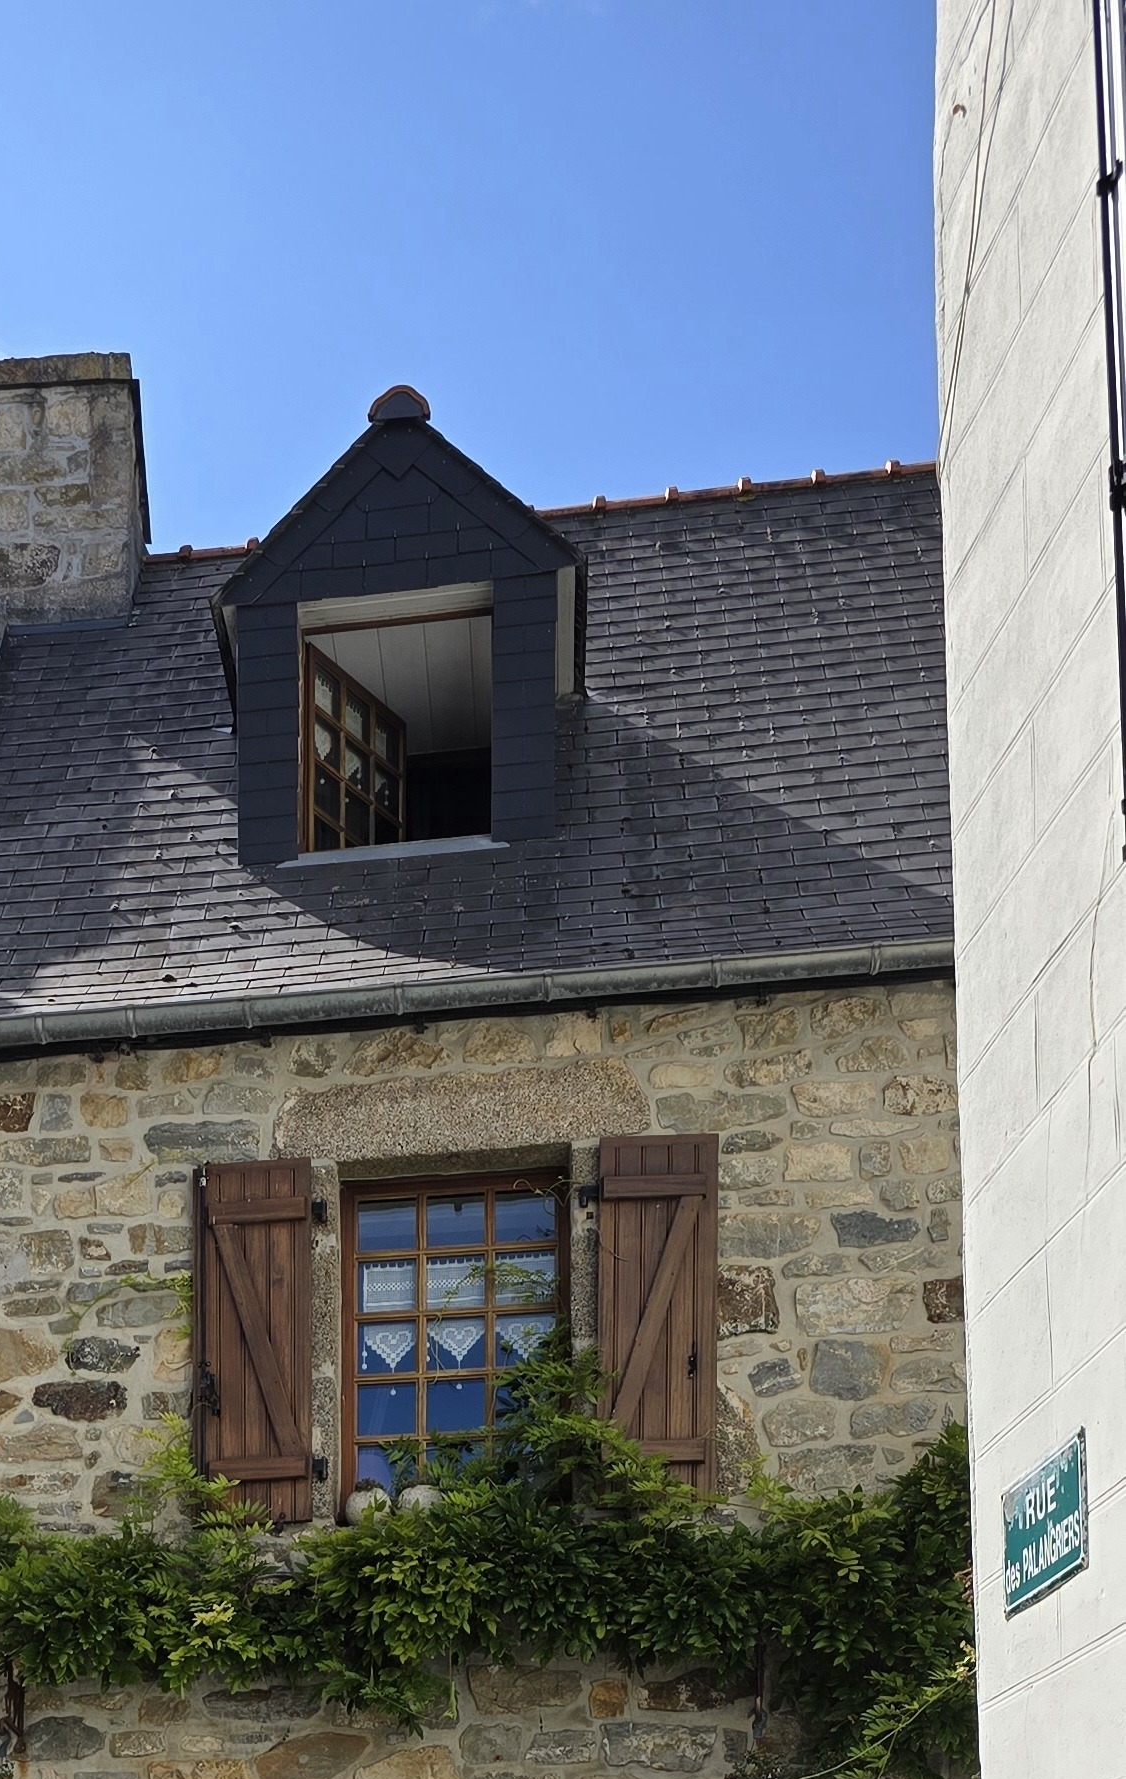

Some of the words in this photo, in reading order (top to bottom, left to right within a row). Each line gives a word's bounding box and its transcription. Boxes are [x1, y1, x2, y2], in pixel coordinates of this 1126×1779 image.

[1025, 1474, 1058, 1530] RUE
[1005, 1558, 1021, 1594] des
[1022, 1514, 1081, 1585] PALANGRIERS
